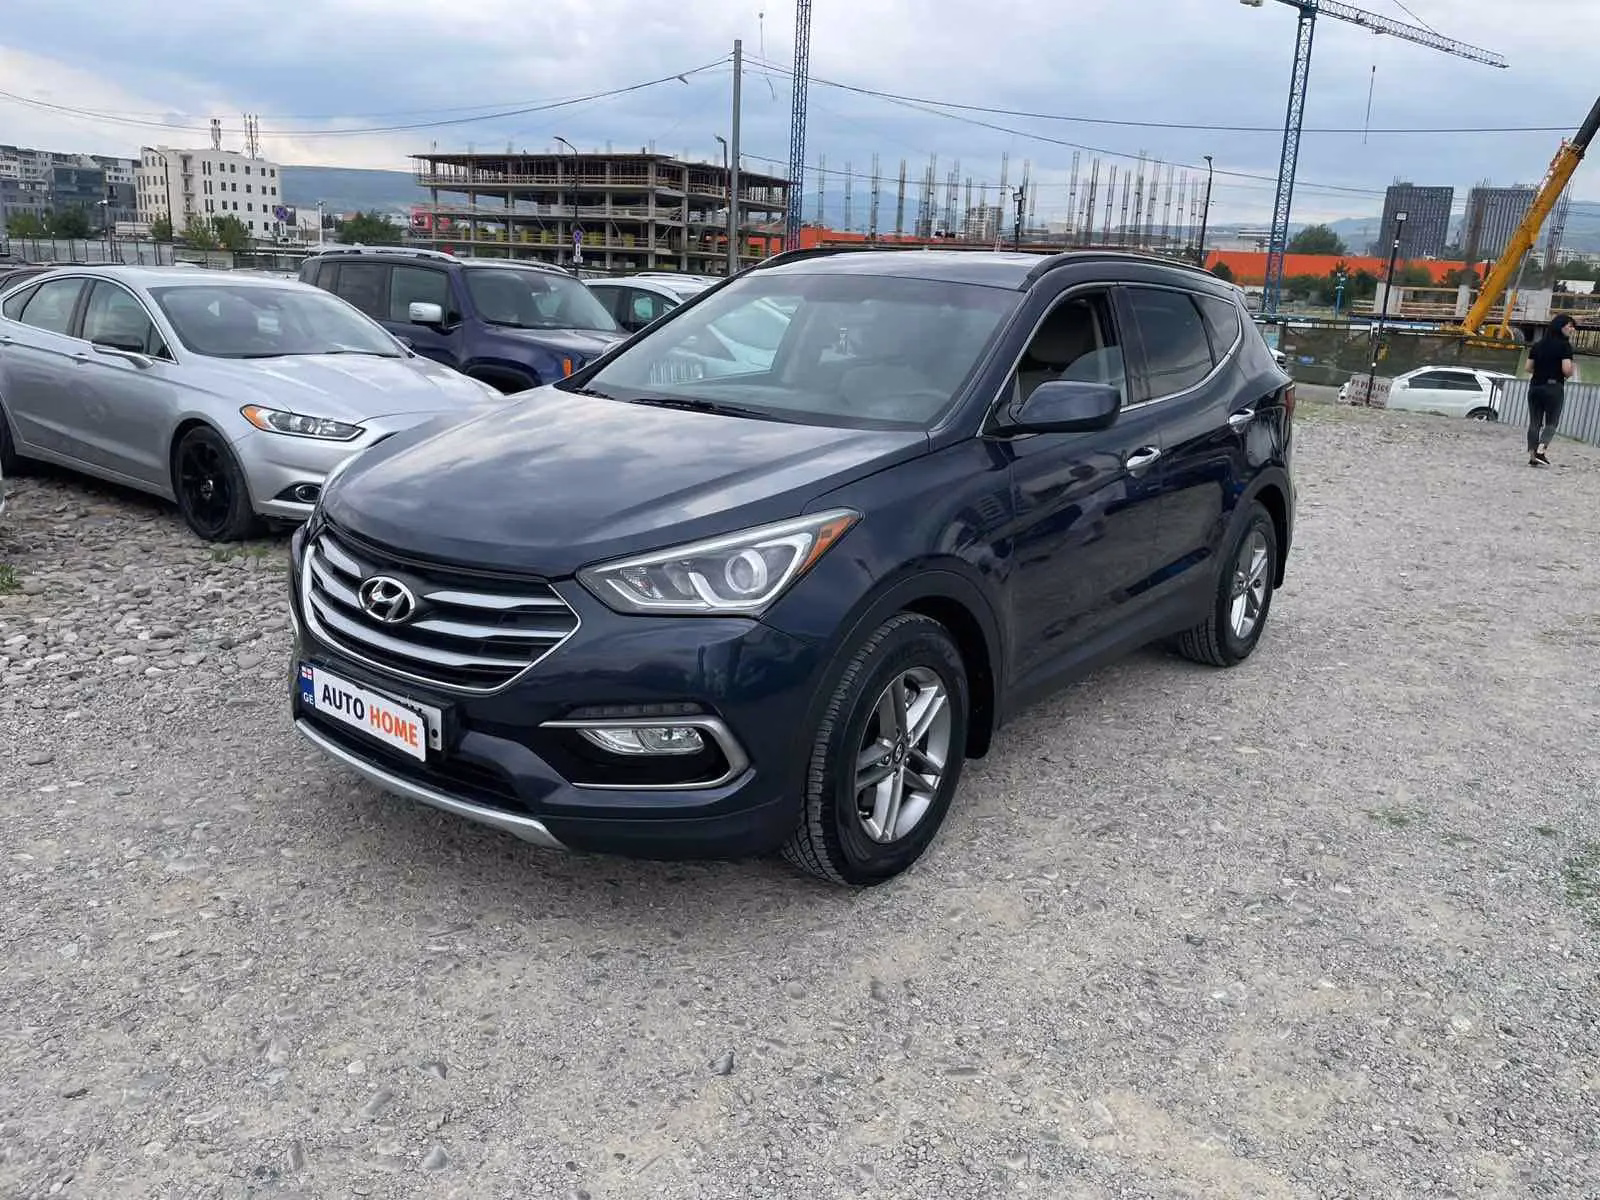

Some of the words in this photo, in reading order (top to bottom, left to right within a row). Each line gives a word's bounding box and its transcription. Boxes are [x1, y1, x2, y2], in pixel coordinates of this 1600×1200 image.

[303, 692, 315, 705] GE
[322, 684, 365, 720] AUTO
[369, 704, 418, 748] HOME
